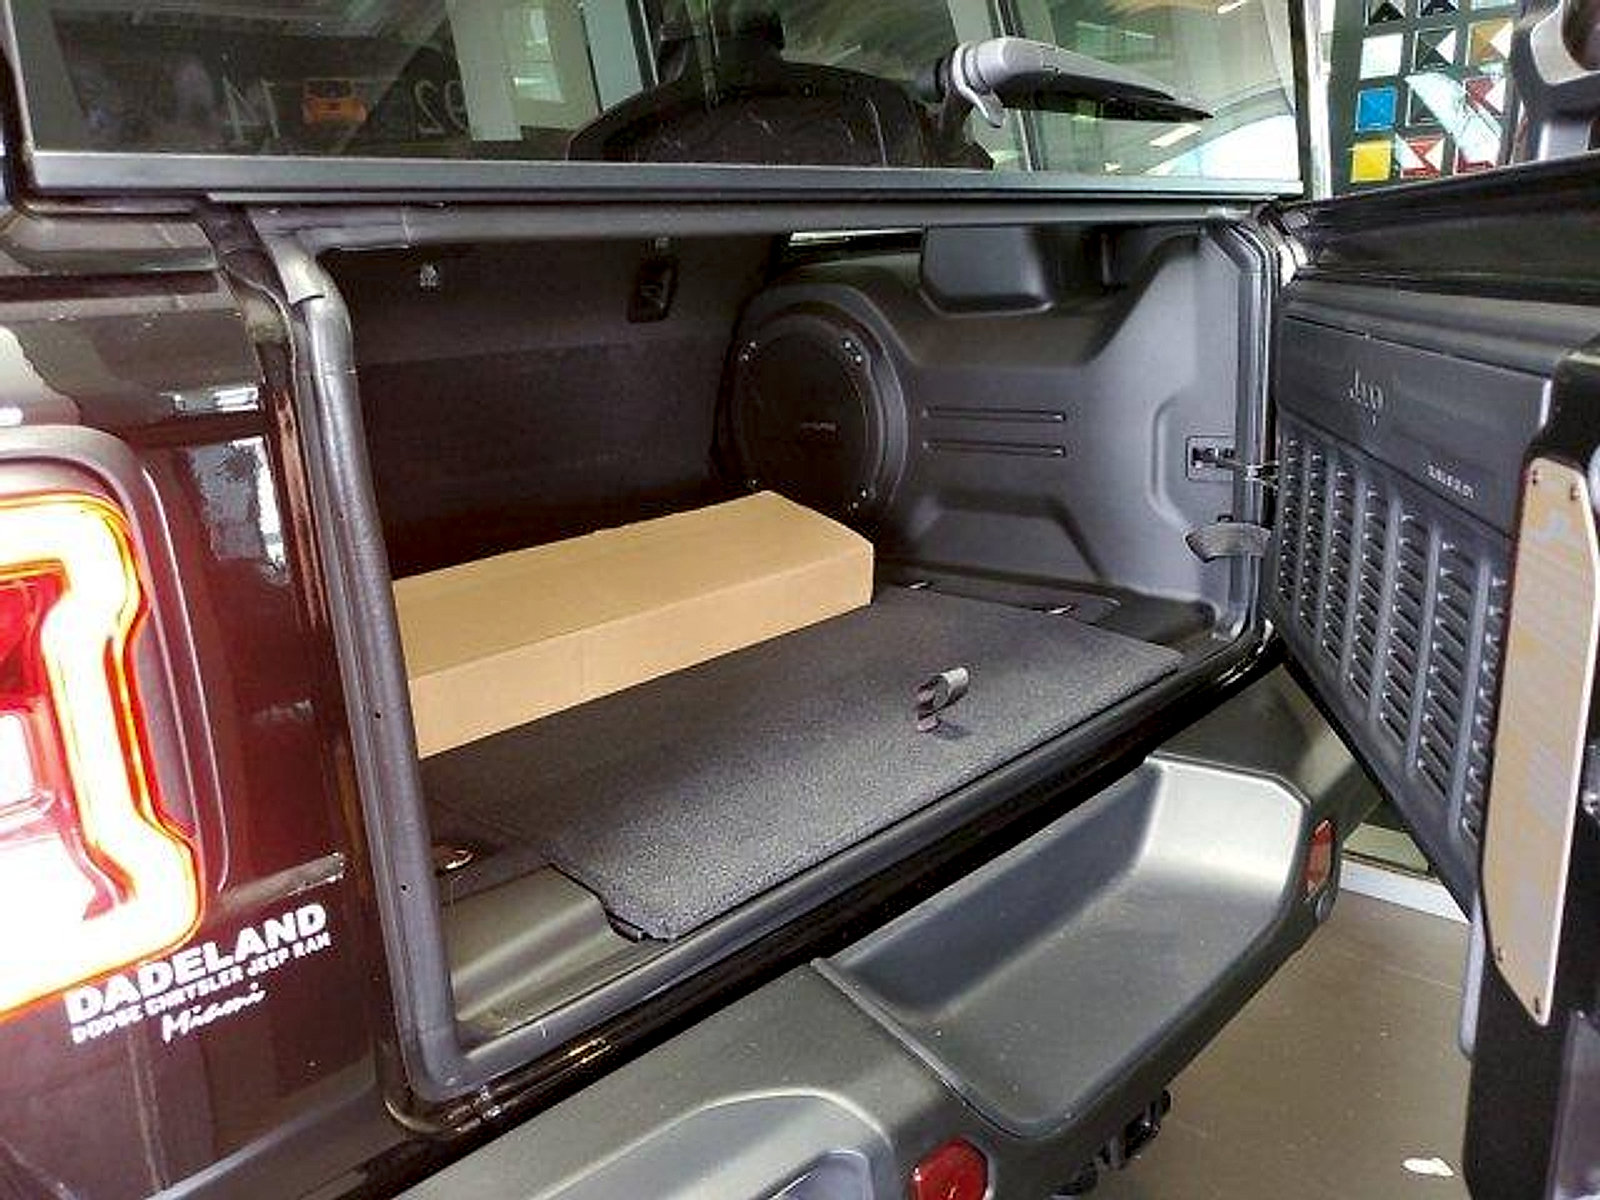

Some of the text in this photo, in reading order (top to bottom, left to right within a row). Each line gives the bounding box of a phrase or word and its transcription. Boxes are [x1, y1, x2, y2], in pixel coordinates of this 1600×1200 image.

[64, 904, 327, 1023] DADELAND
[247, 947, 289, 976] JEEP
[292, 931, 332, 959] RAM
[161, 982, 267, 1044] Miami
